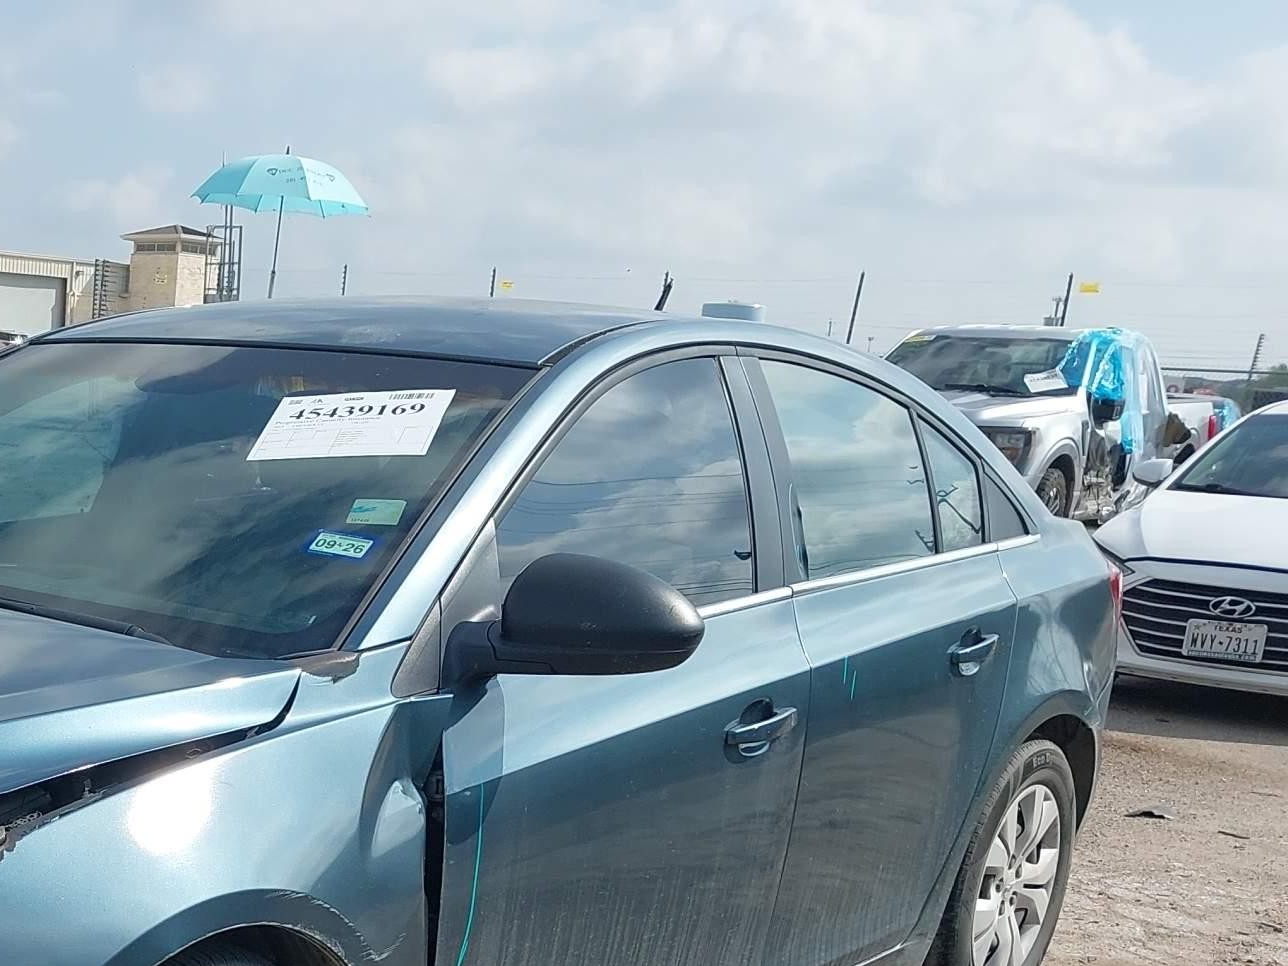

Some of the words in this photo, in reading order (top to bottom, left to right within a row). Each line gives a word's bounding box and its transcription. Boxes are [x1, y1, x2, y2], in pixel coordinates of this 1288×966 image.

[289, 402, 426, 420] 45439169
[315, 538, 337, 549] 09
[342, 543, 365, 554] 26
[1214, 625, 1243, 634] TEXAS
